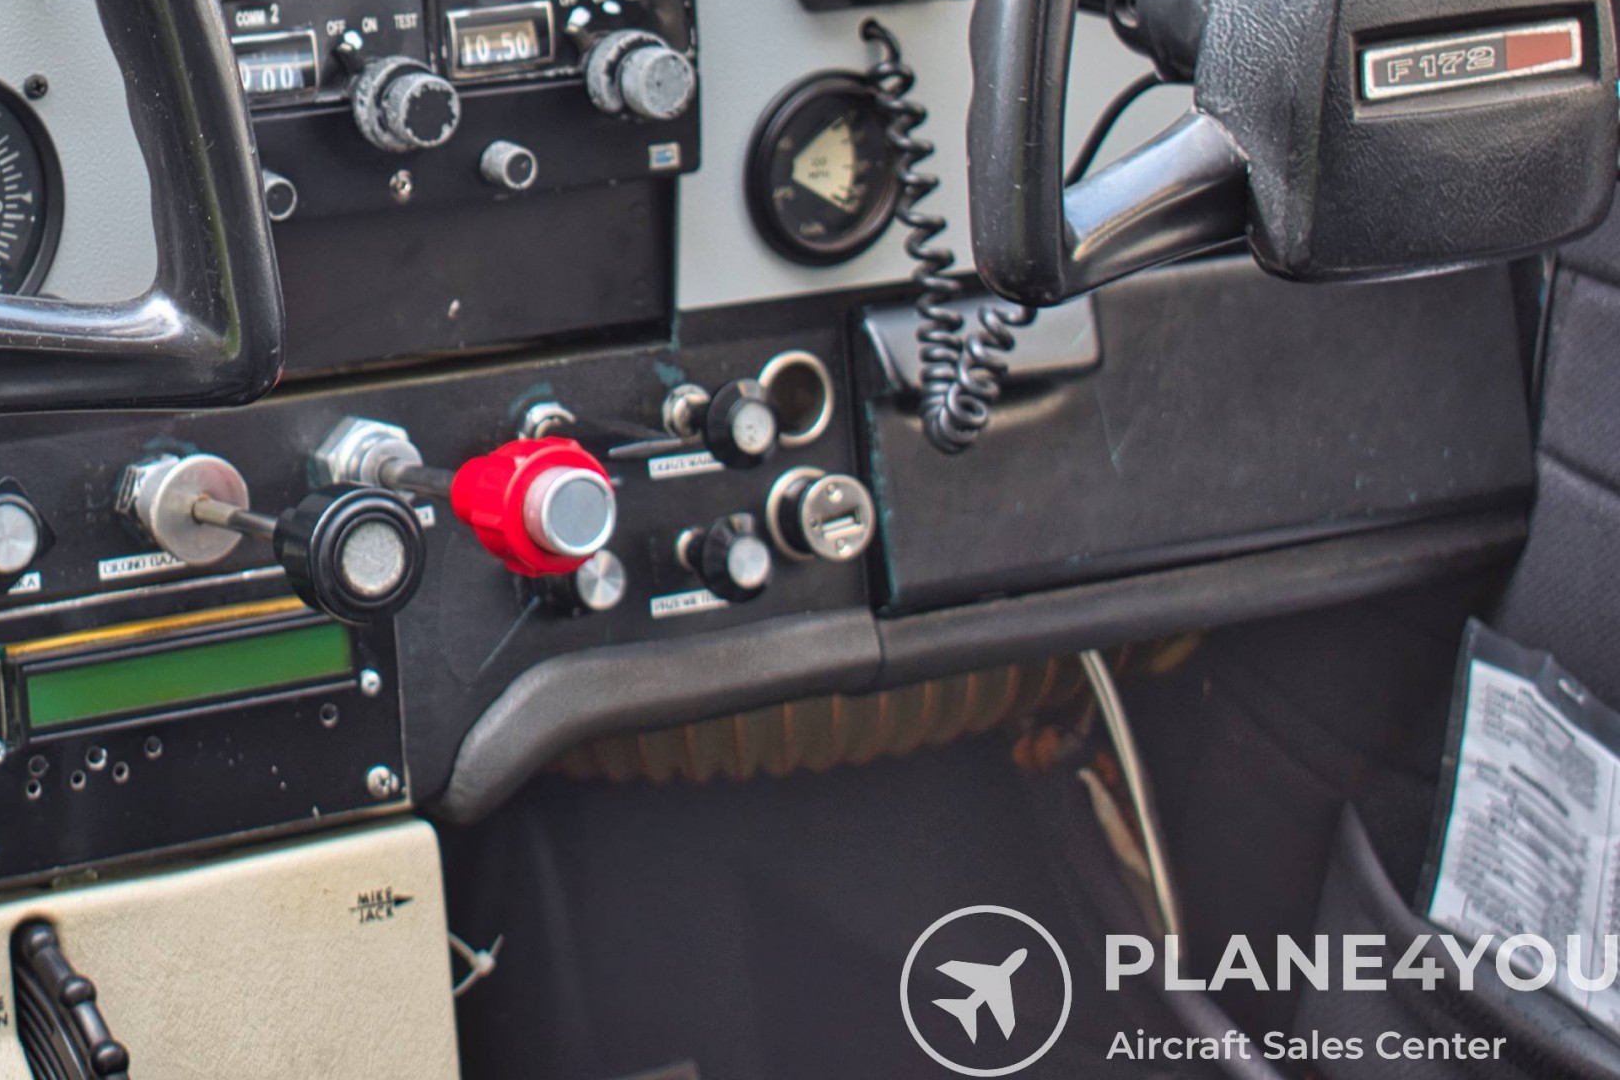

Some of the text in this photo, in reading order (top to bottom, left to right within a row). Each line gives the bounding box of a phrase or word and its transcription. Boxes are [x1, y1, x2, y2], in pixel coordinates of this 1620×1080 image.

[326, 20, 346, 36] OFF
[362, 17, 378, 33] ON
[394, 13, 419, 29] TEST
[358, 886, 393, 905] MIKE
